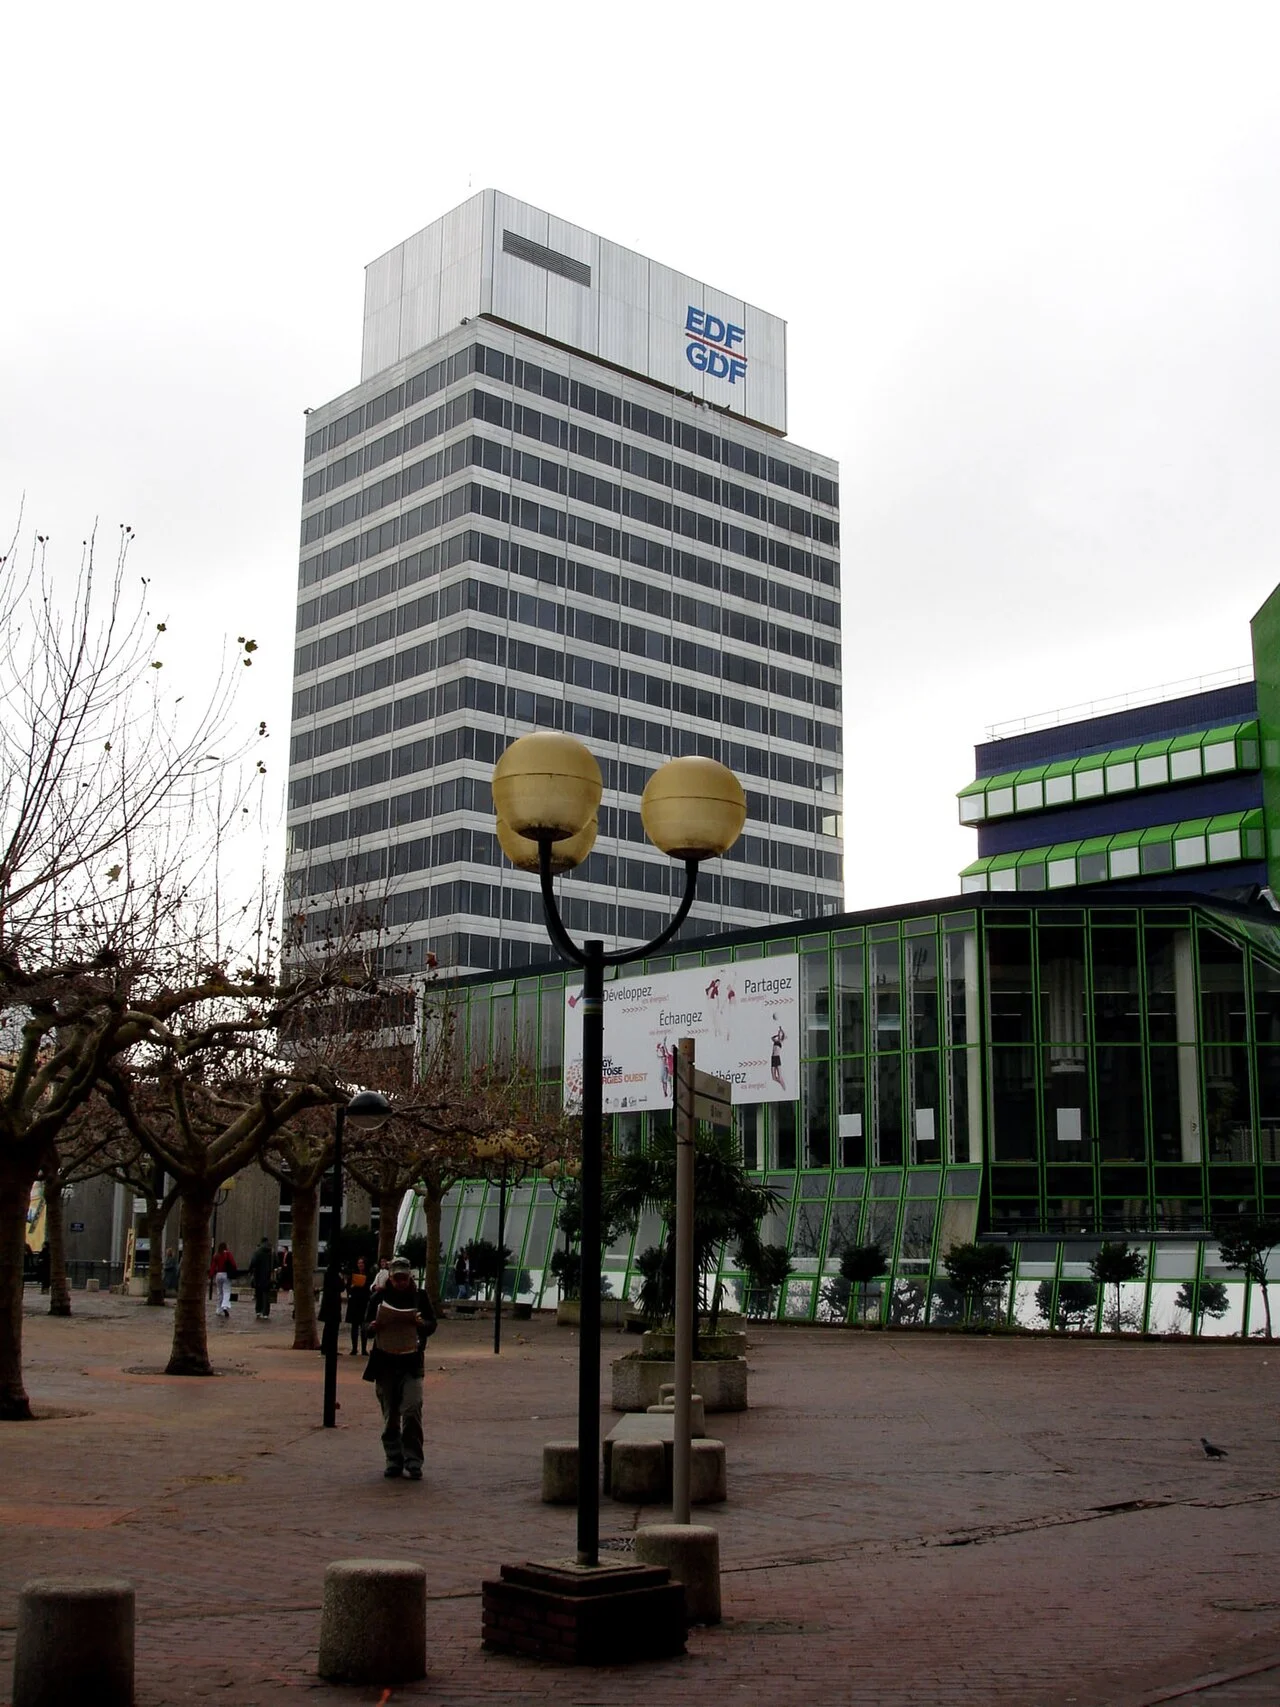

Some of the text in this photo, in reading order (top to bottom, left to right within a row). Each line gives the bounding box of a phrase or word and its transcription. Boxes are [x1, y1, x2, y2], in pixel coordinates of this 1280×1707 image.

[685, 305, 746, 348] EDF
[685, 342, 748, 384] GDF
[603, 986, 652, 1002] Développez
[744, 977, 792, 994] Partagez
[659, 1010, 703, 1026] Échangez
